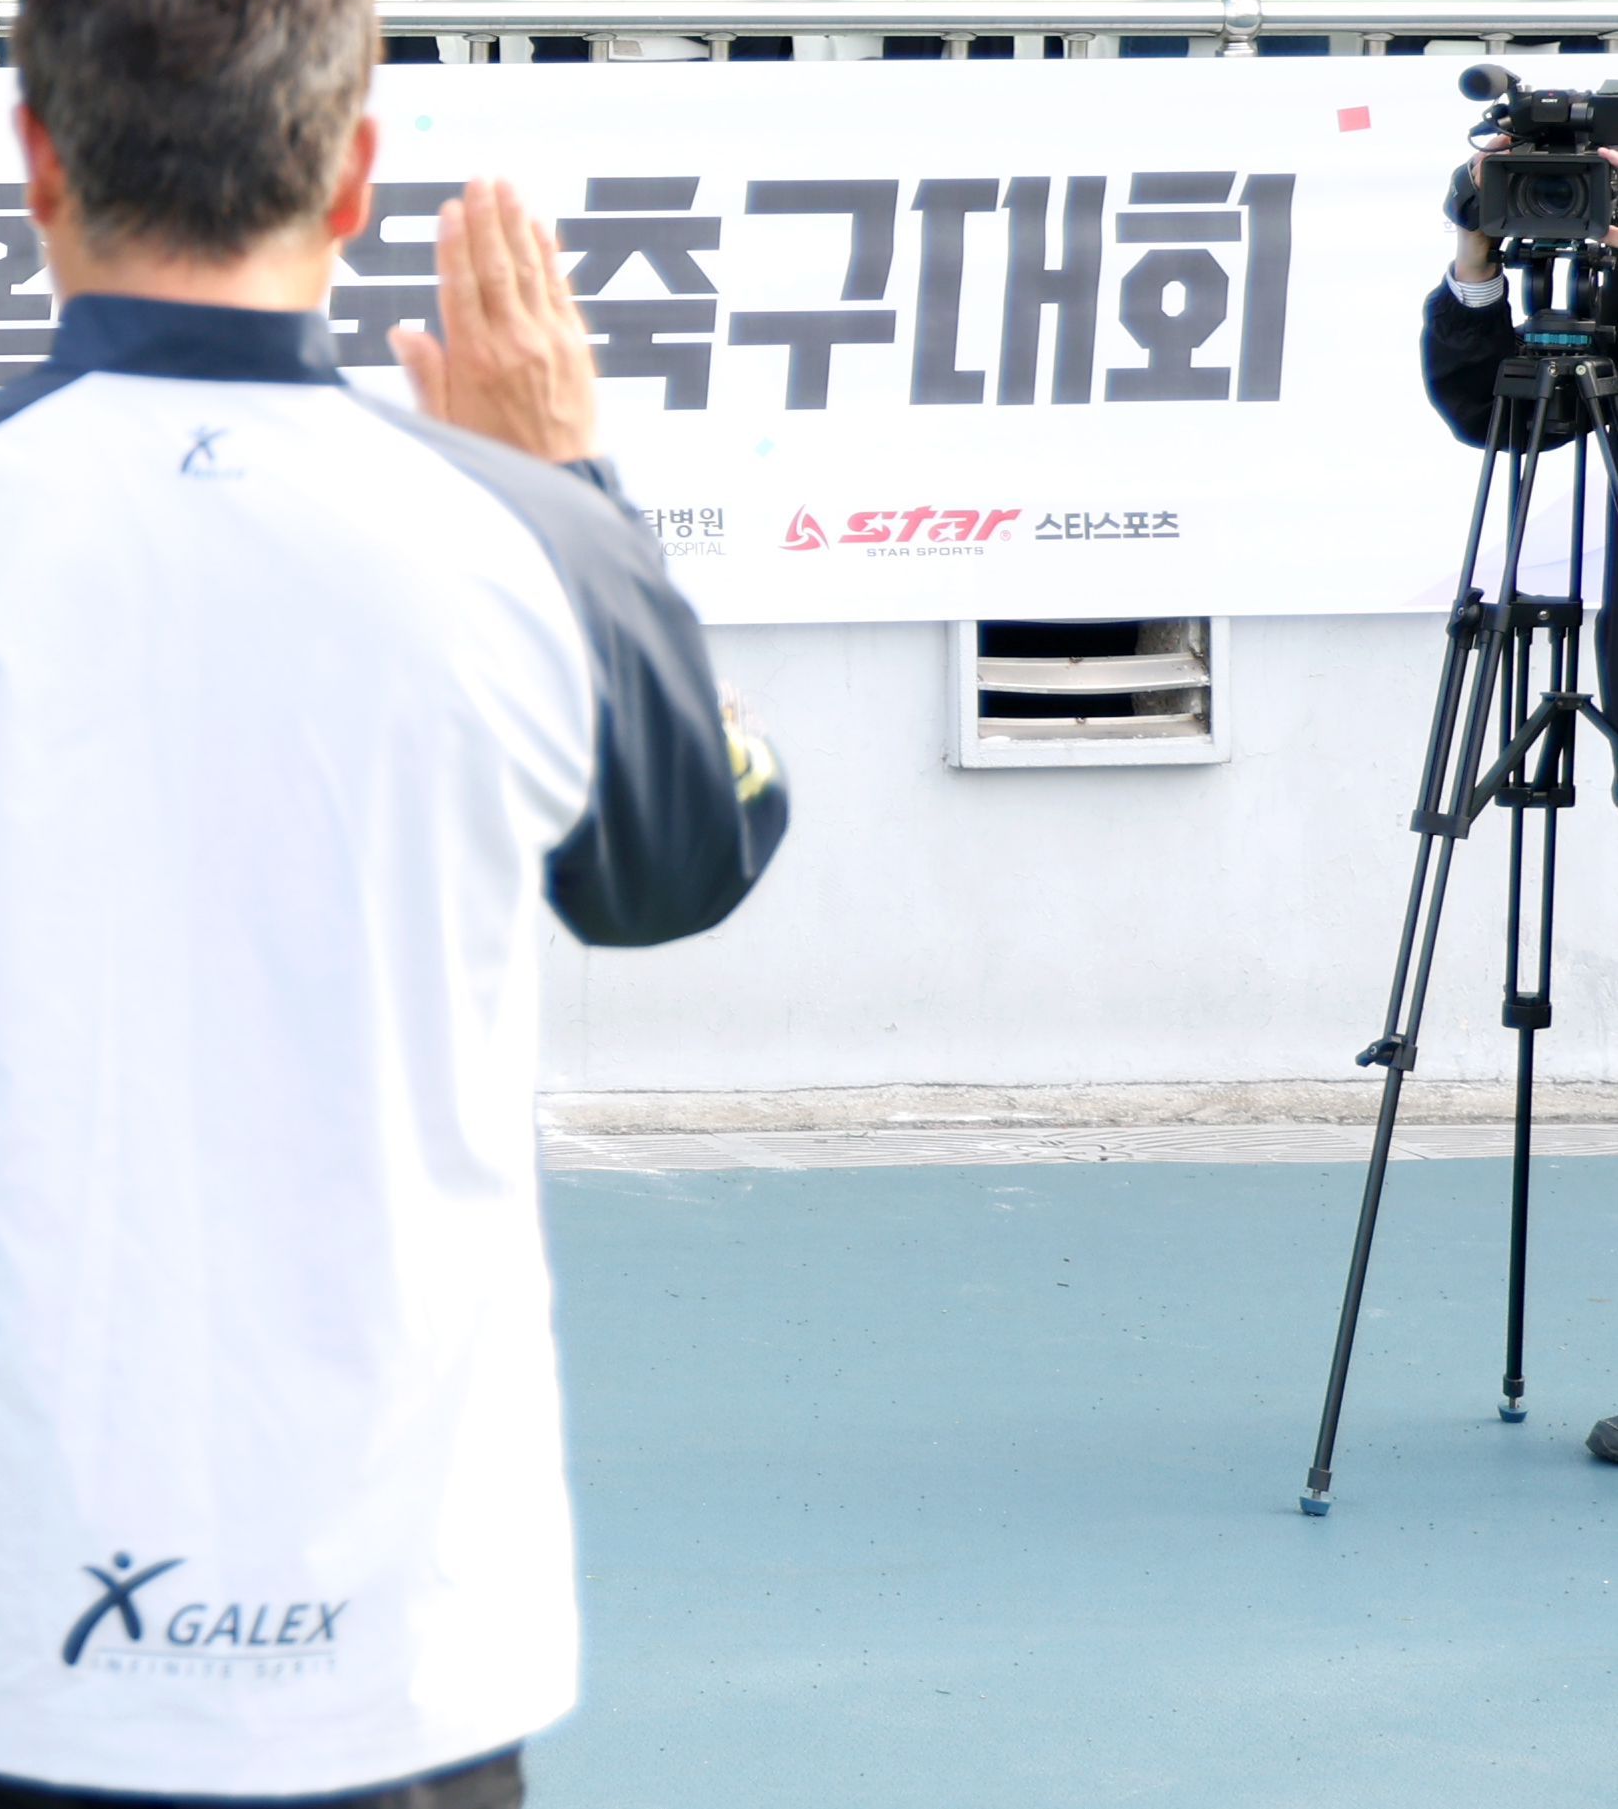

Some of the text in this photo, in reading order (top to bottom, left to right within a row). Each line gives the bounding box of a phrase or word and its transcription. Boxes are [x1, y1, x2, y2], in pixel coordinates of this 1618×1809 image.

[554, 171, 1296, 410] 축구대회
[1035, 510, 1180, 540] 스타스포츠
[660, 542, 726, 556] OSPITAL
[867, 546, 984, 557] STAR SPORTS
[165, 1599, 350, 1648] GALEX
